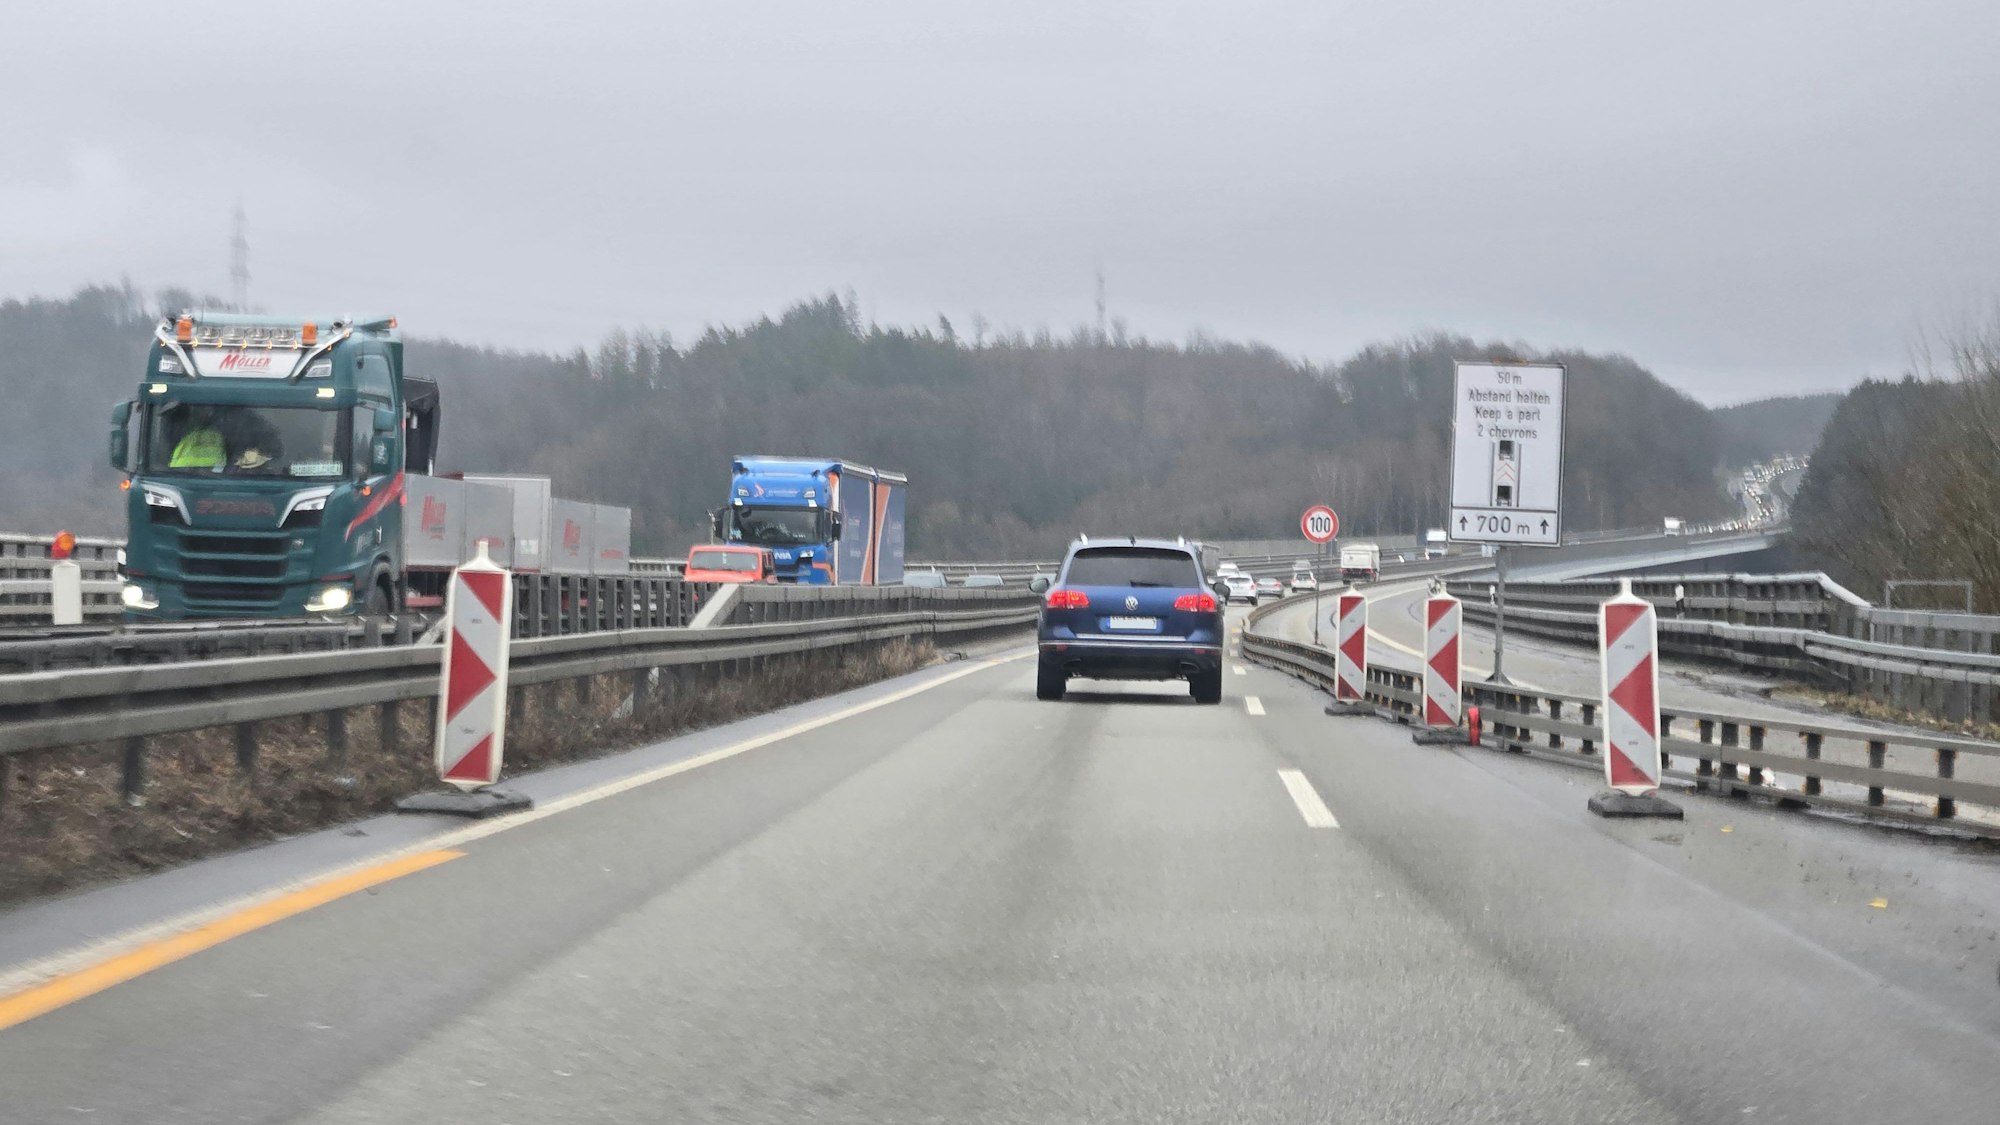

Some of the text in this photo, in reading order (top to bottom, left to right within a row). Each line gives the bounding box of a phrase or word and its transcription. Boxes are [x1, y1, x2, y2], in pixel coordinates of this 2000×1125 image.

[1497, 371, 1522, 384] 50 m
[1468, 388, 1551, 405] Abstand halten
[1474, 406, 1541, 423] Keep a part
[1477, 424, 1538, 439] 2 chevrons
[1310, 516, 1331, 533] 100
[1477, 515, 1531, 535] 700 m
